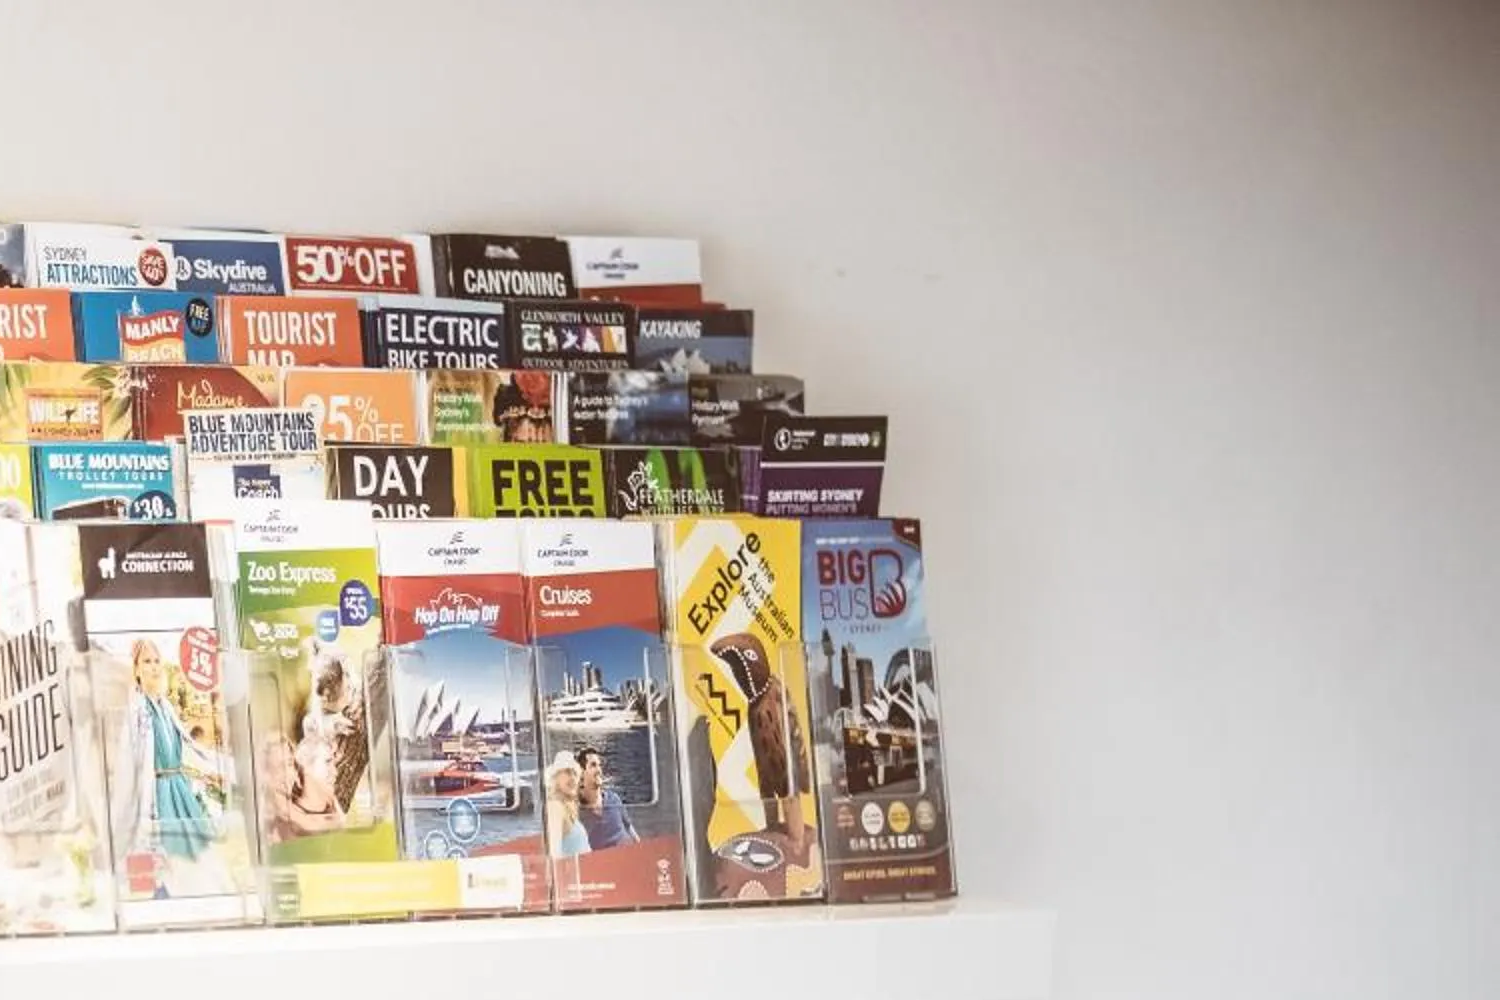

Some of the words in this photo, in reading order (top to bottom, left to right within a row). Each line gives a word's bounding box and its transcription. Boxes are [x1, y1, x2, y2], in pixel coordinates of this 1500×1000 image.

[43, 246, 87, 261] SYDNEY
[297, 245, 354, 284] 50%
[355, 247, 407, 286] OFF
[47, 263, 137, 287] ATTRACTIONS
[194, 258, 267, 283] Skydive
[463, 268, 567, 297] CANYONING
[227, 282, 277, 294] AUSTRALIA
[125, 315, 181, 341] MANLY
[243, 311, 336, 346] TOURIST
[583, 311, 625, 324] VALLEY
[639, 319, 703, 339] KAYAKING
[385, 313, 499, 348] ELECTRIC
[388, 349, 428, 369] BIKE
[433, 351, 498, 370] TOURS
[522, 357, 564, 370] OUTDOOR
[568, 358, 630, 371] ADVENTURES
[189, 414, 227, 434] BLUE
[231, 411, 315, 433] MOUNTAINS
[356, 421, 405, 443] OFF
[190, 433, 277, 454] ADVENTURE
[280, 431, 318, 452] TOUR
[49, 453, 85, 470] BLUE
[88, 453, 170, 472] MOUNTAINS
[354, 455, 429, 497] DAY
[491, 460, 594, 505] FREE
[639, 488, 725, 505] FEATHERDALE
[767, 489, 819, 503] SKIRTING
[821, 489, 864, 501] SYDNEY
[121, 559, 195, 574] CONNECTION
[247, 562, 277, 581] Zoo
[279, 562, 337, 587] Express
[757, 557, 775, 583] the
[817, 550, 866, 585] BIG
[540, 585, 593, 605] Cruises
[687, 531, 762, 635] Explore
[414, 606, 437, 626] Hop
[439, 606, 456, 623] On
[457, 605, 480, 624] Hop
[481, 605, 500, 622] Off
[738, 585, 779, 643] Museum
[748, 574, 795, 640] Australian
[820, 587, 871, 621] BUS
